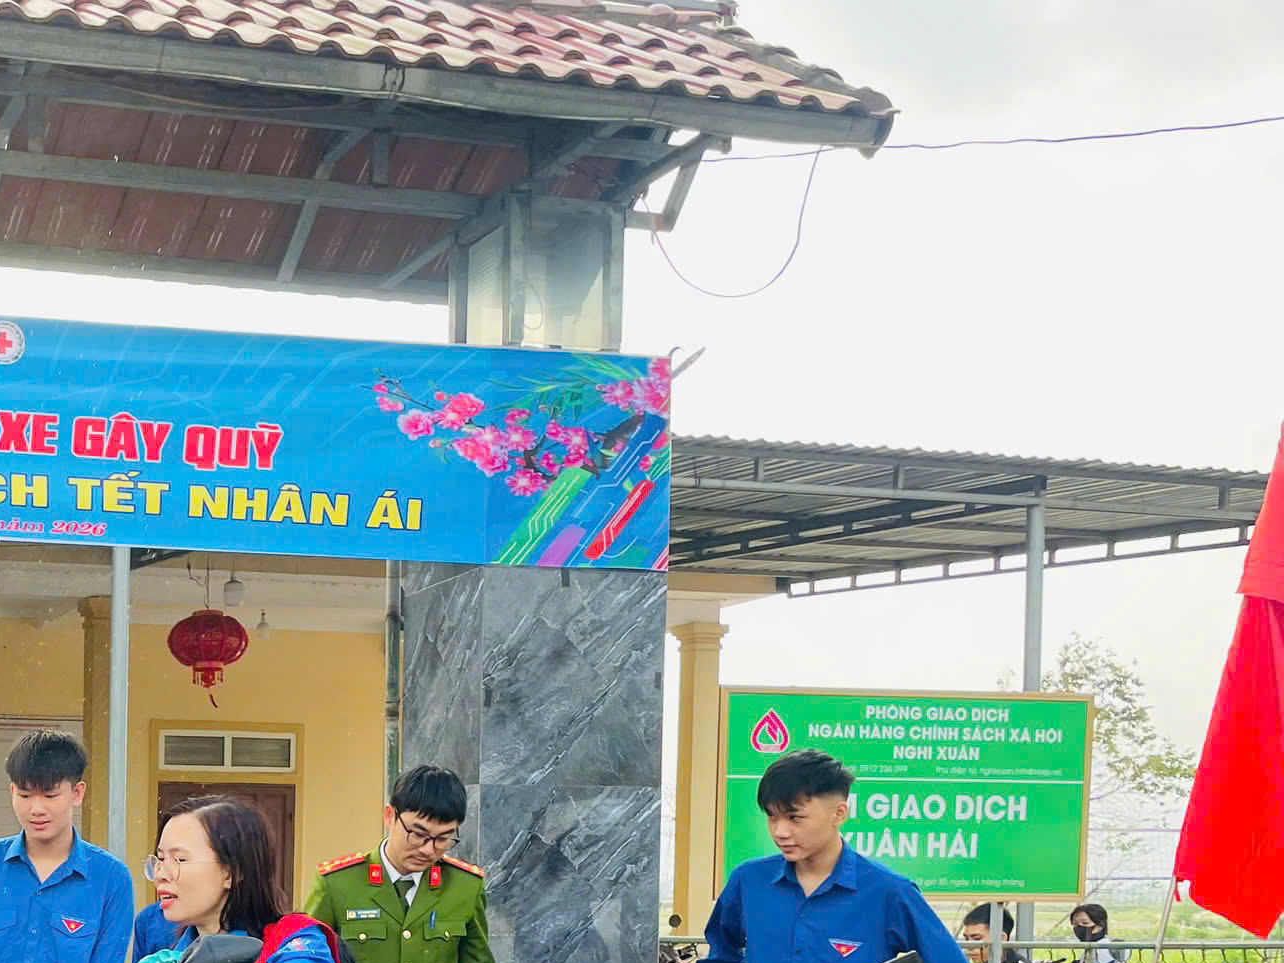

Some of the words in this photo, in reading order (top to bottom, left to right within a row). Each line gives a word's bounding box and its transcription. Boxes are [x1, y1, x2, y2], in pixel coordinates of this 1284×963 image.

[71, 411, 173, 463] GÂY
[183, 421, 284, 471] QUỸ
[68, 469, 171, 516] TẾT
[188, 483, 351, 527] NHÂN
[366, 489, 424, 531] ÁI
[51, 520, 109, 537] 2026
[865, 704, 923, 720] PHÒNG
[926, 706, 968, 721] GIAO
[971, 708, 1010, 724] DỊCH
[859, 723, 906, 739] HÀNG
[909, 724, 959, 740] CHÍNH
[962, 725, 1005, 741] SÁCH
[892, 745, 933, 760] NGHI
[936, 744, 980, 760] XUÂN
[865, 793, 947, 820] GIAO
[954, 795, 1028, 824] DỊCH
[927, 828, 980, 858] HẢI
